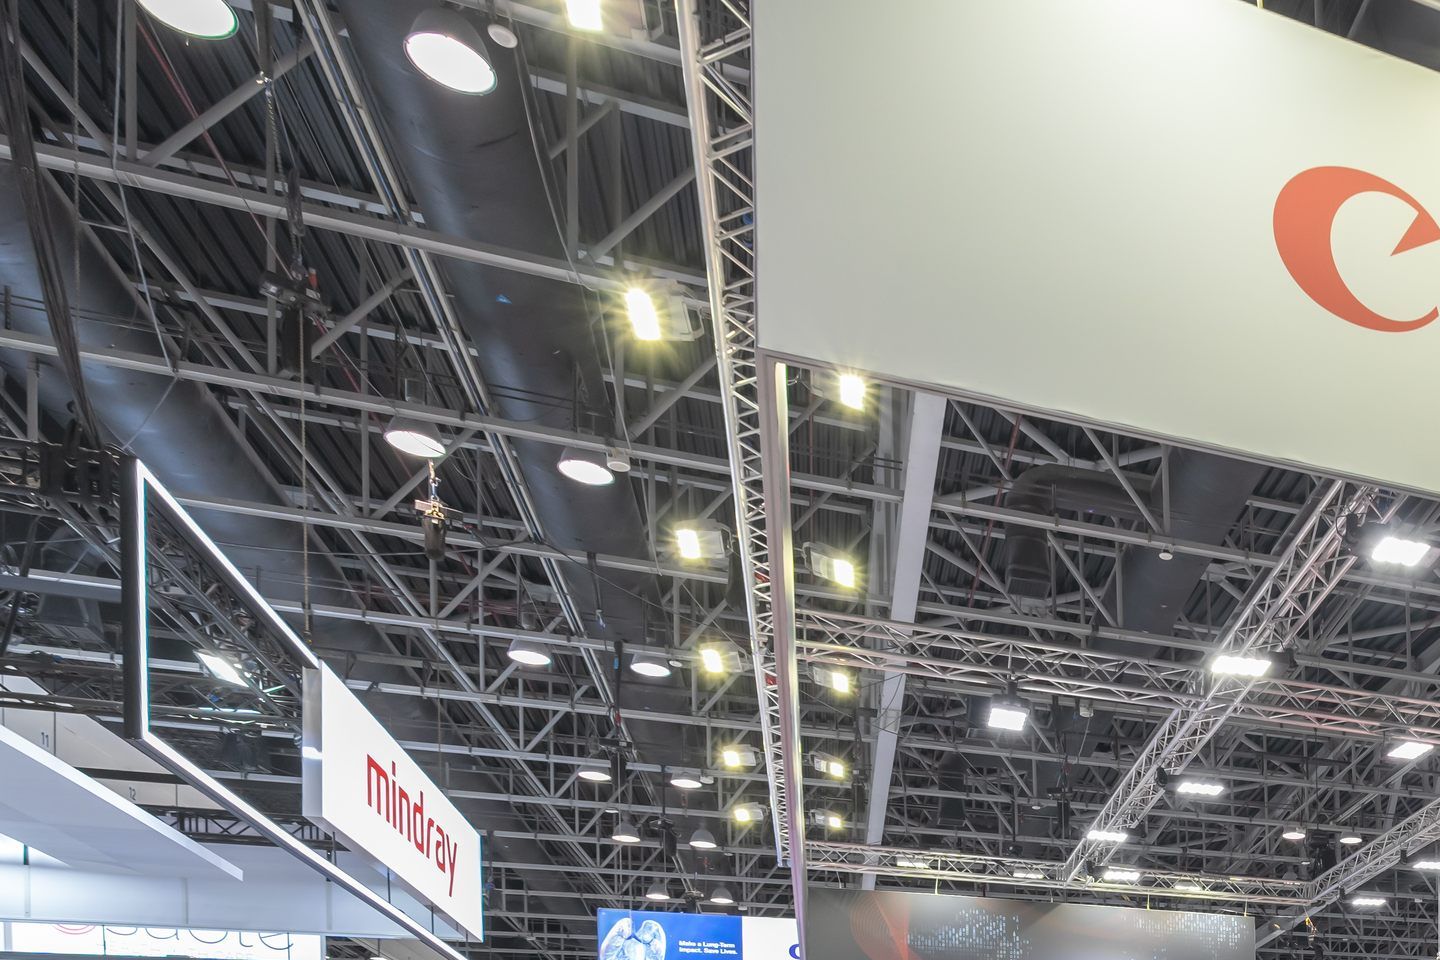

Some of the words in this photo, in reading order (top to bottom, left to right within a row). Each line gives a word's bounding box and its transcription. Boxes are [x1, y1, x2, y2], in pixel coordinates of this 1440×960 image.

[366, 753, 458, 898] mindray
[679, 940, 697, 948] Make
[702, 941, 736, 949] Lung-Term
[679, 946, 703, 954] Impact.
[703, 947, 720, 955] Save
